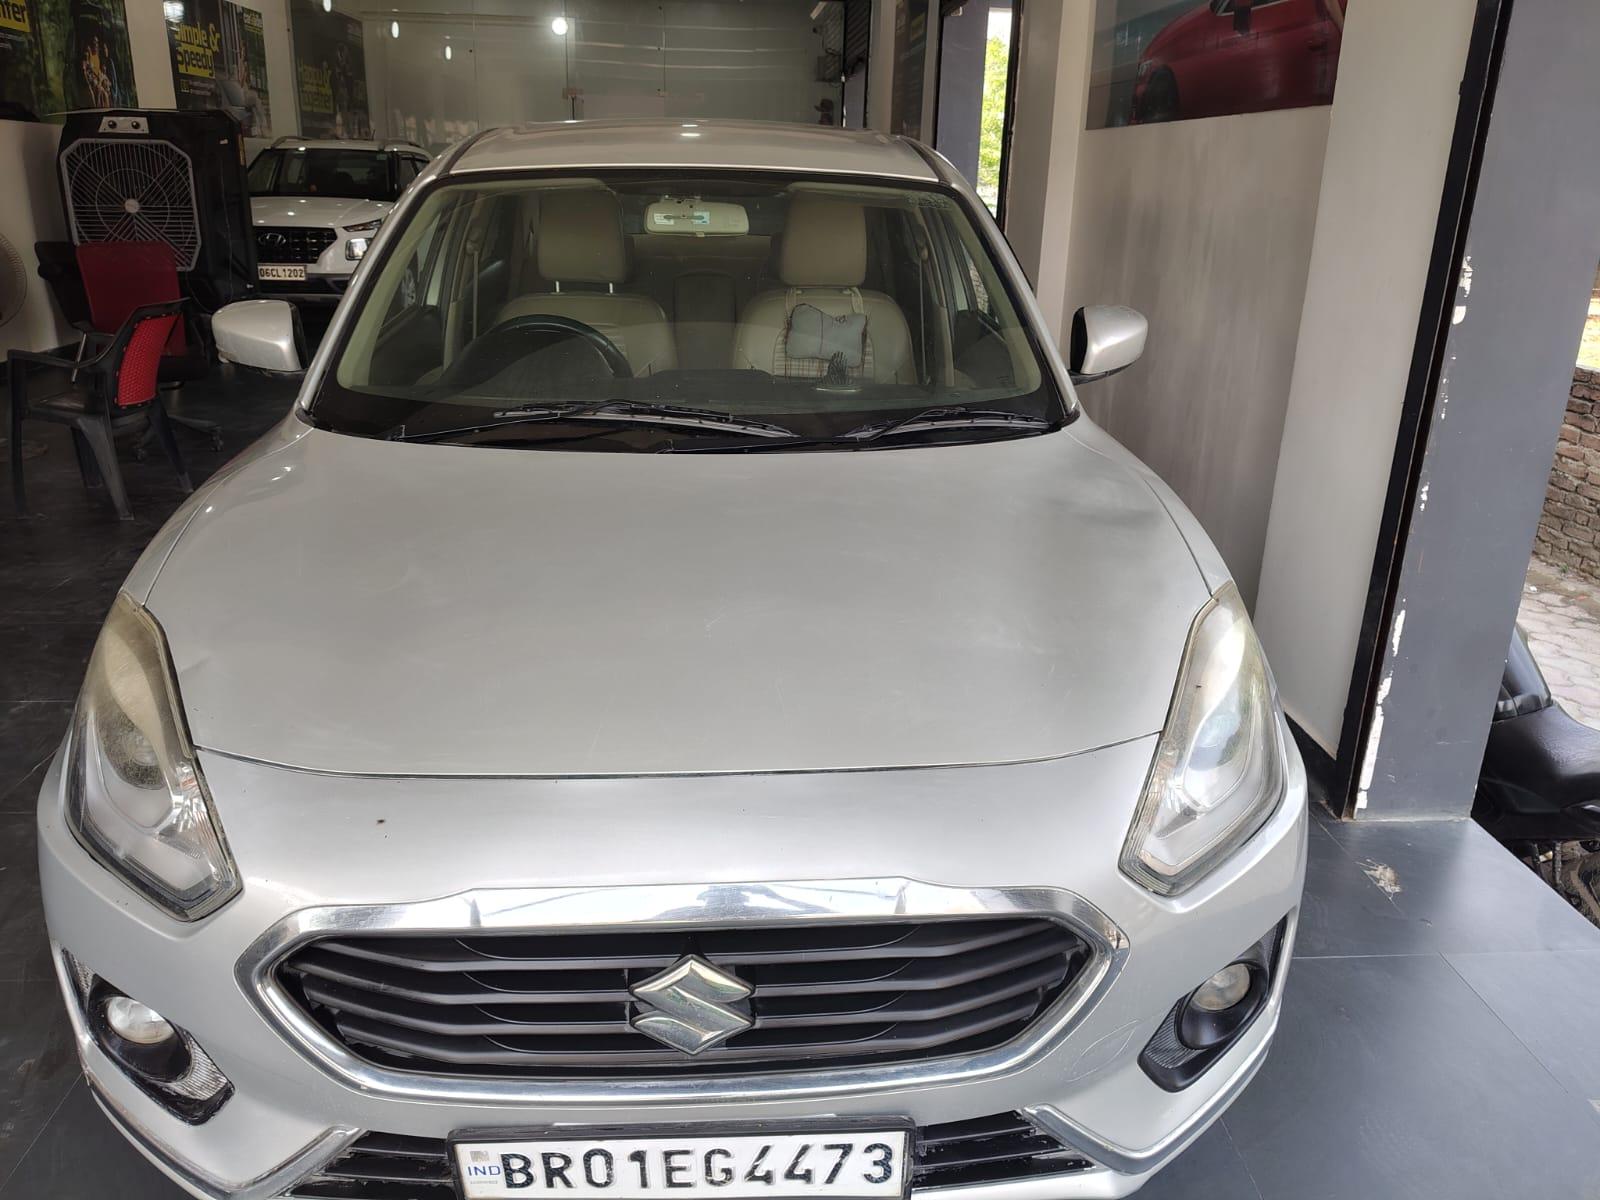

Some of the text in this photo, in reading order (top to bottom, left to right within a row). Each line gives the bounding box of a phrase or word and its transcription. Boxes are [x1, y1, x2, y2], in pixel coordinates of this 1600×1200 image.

[199, 23, 220, 52] &
[176, 42, 214, 77] Speedy
[467, 1165, 501, 1177] IND
[500, 1142, 896, 1190] BR01EG4473
